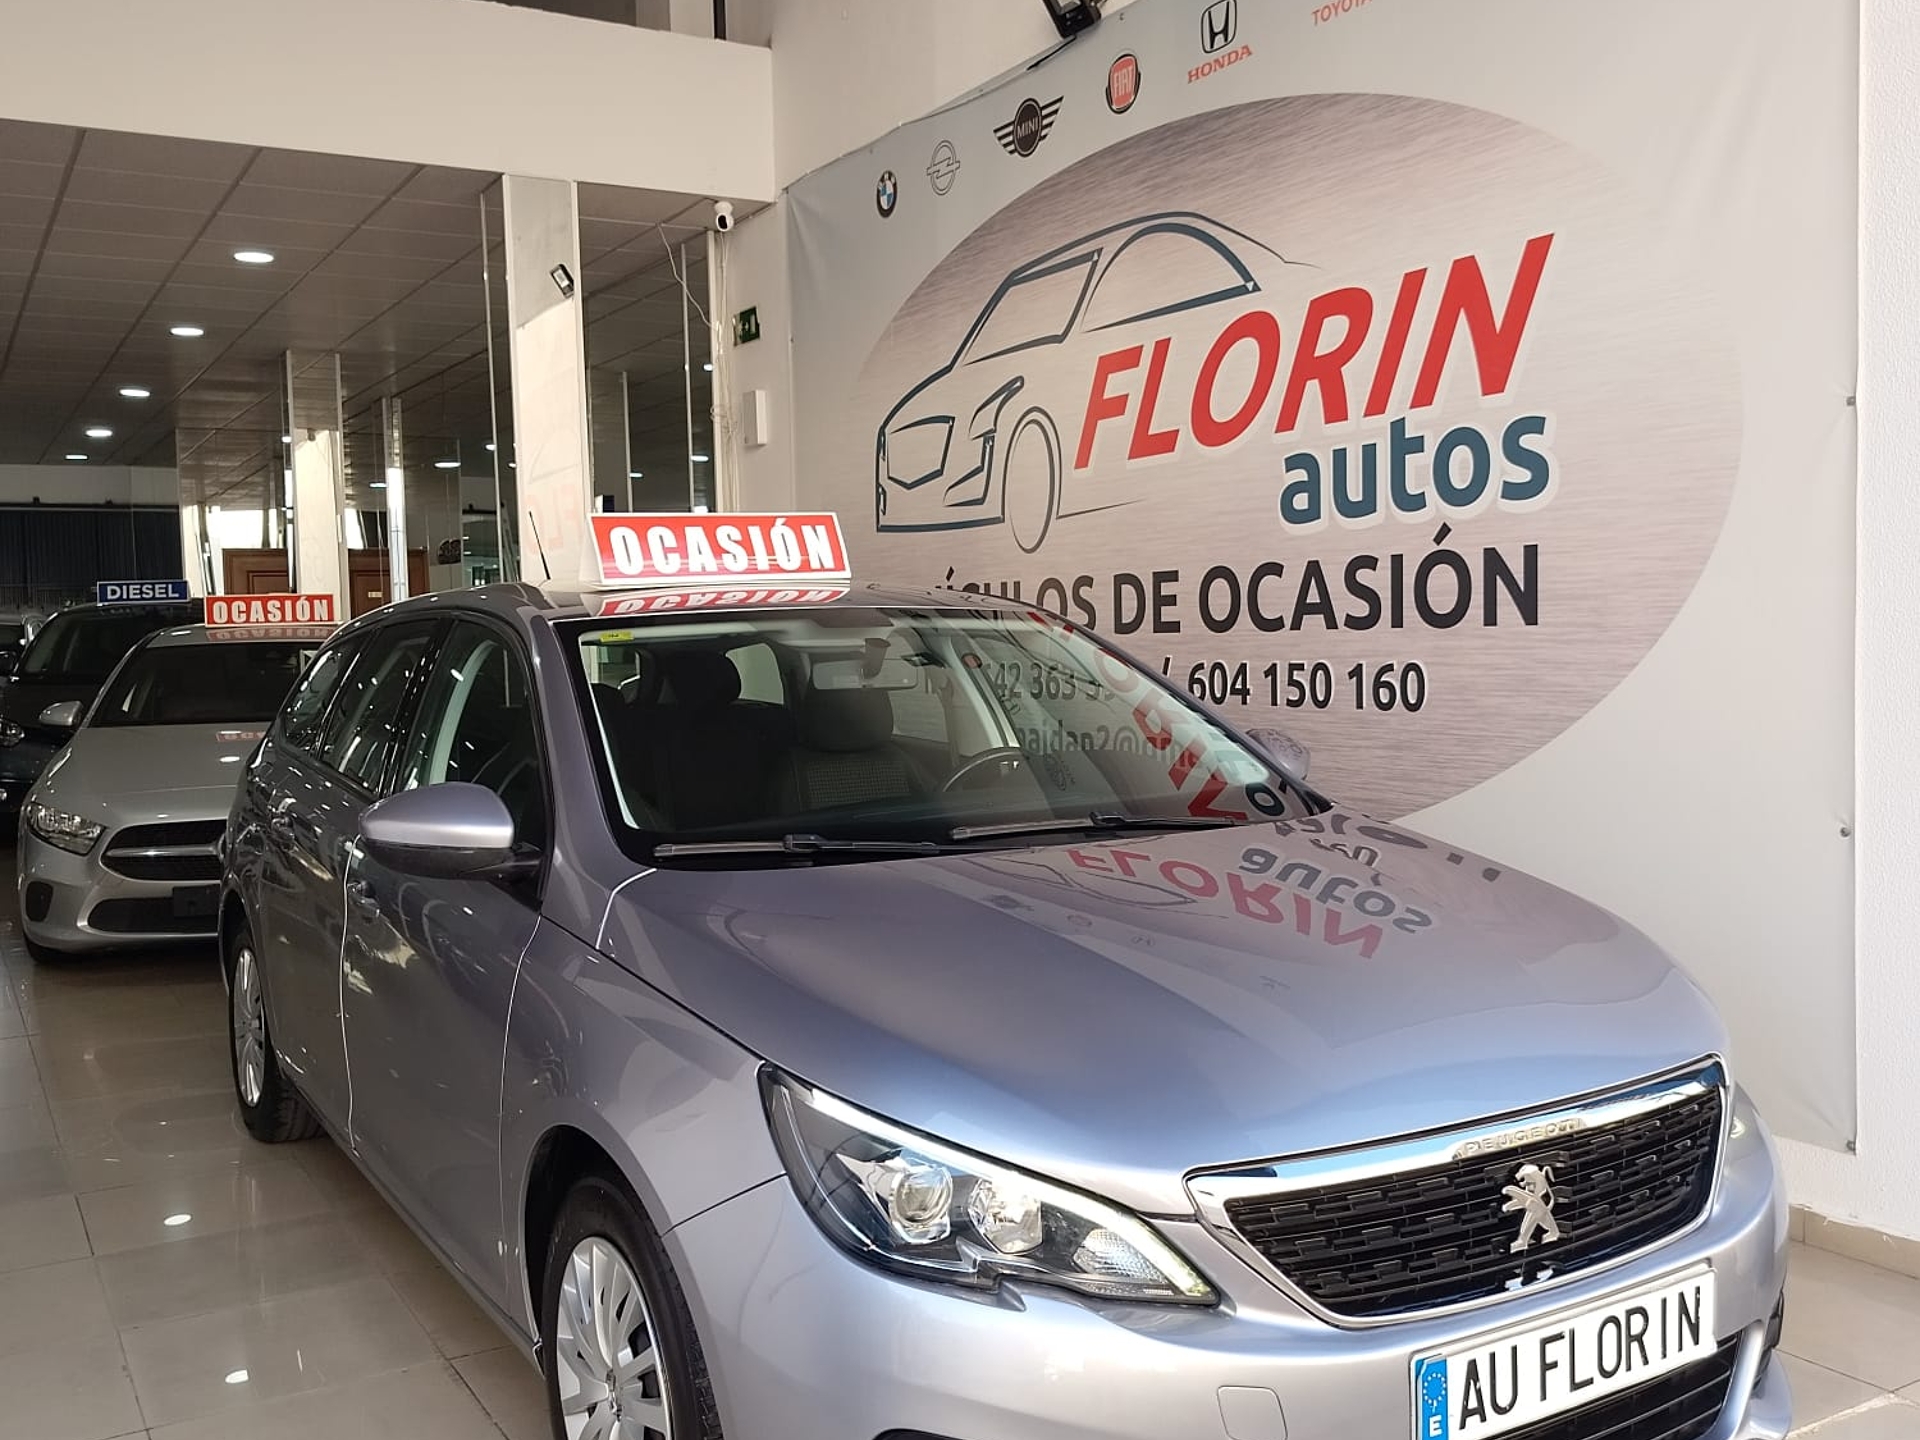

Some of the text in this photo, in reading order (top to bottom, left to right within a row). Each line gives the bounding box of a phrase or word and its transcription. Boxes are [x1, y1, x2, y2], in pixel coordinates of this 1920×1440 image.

[1113, 65, 1134, 98] FIAT
[1187, 44, 1253, 84] HONDA
[1017, 117, 1039, 139] MINI
[1073, 232, 1555, 470] FLORIN
[1279, 416, 1549, 525] autos
[608, 517, 836, 576] OCASIÓN
[106, 583, 180, 600] DIESEL
[1112, 568, 1182, 635] DE
[1198, 522, 1539, 634] OCASIÓN
[212, 595, 330, 624] OCASIÓN
[1188, 661, 1251, 706] 604
[1263, 661, 1333, 709] 150
[1347, 661, 1427, 713] 160
[1463, 1118, 1577, 1152] PEUGEOT
[1458, 1286, 1701, 1430] AU FLORIN
[1429, 1414, 1443, 1438] E
